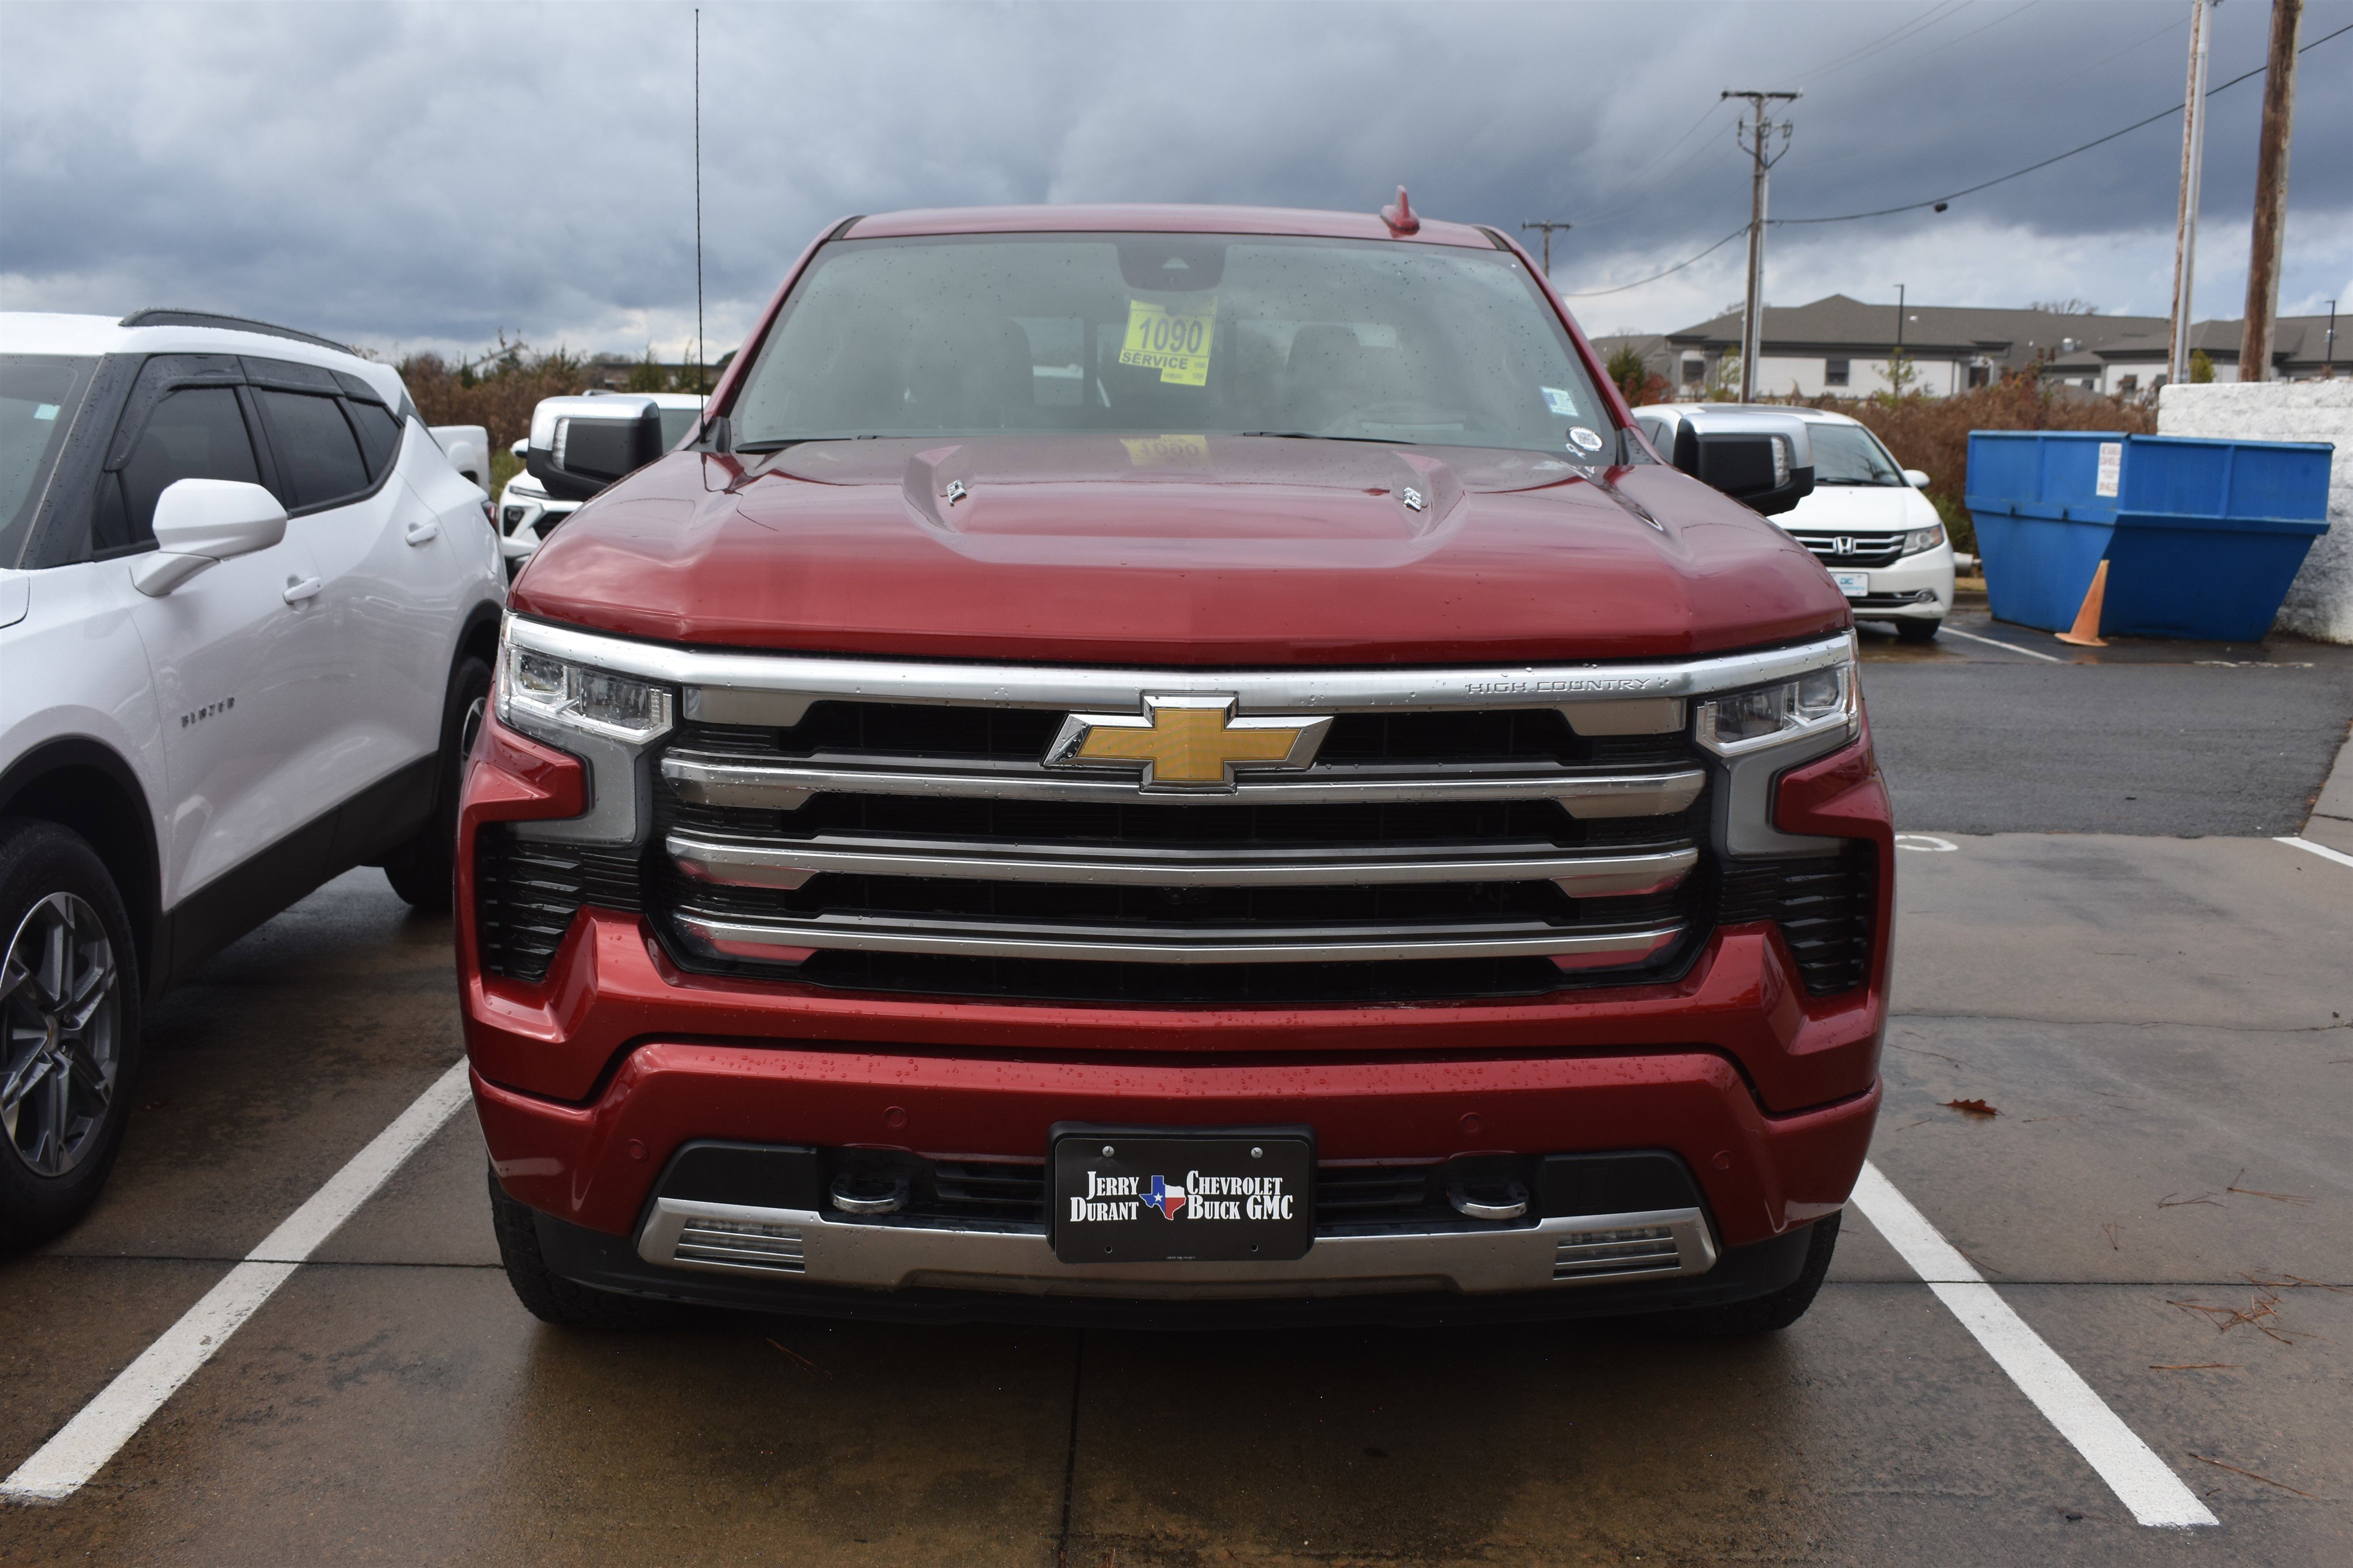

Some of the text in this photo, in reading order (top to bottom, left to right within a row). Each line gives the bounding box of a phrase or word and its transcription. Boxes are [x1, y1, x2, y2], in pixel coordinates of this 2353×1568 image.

[1139, 317, 1203, 354] 1090
[1121, 352, 1189, 370] SERVICE
[1468, 678, 1650, 694] HIGH COUNTRY
[1086, 1170, 1283, 1200] JERRY CHEVROLET
[1070, 1195, 1293, 1222] DURANT BUICK GMC
